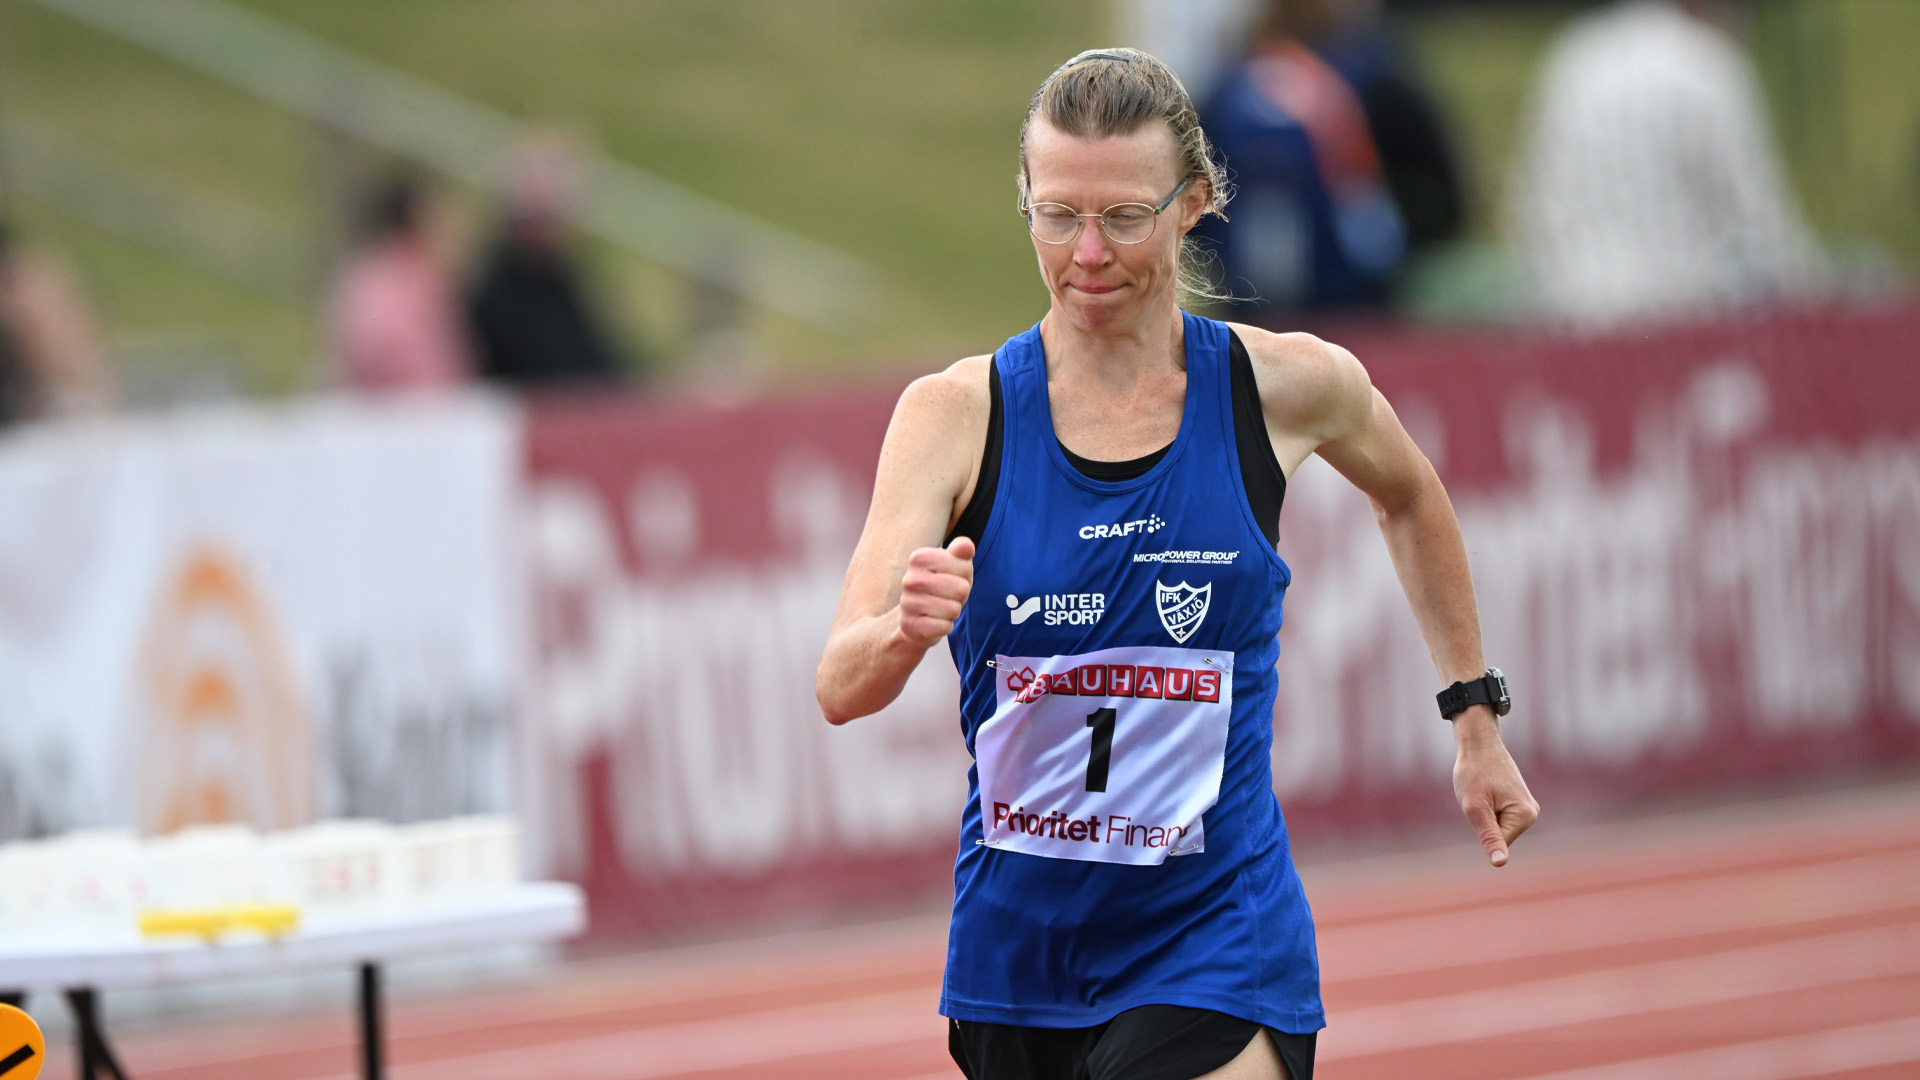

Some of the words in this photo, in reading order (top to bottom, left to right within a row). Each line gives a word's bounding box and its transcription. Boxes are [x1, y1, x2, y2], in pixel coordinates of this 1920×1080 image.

[1079, 519, 1148, 540] CRAFT
[1045, 593, 1105, 610] INTER
[1161, 592, 1181, 604] IFK
[1167, 596, 1204, 625] VÄXJÖ
[1044, 609, 1105, 626] SPORT
[1018, 667, 1217, 701] BAUHAUS
[1085, 707, 1117, 793] 1
[993, 801, 1102, 843] Prioritet
